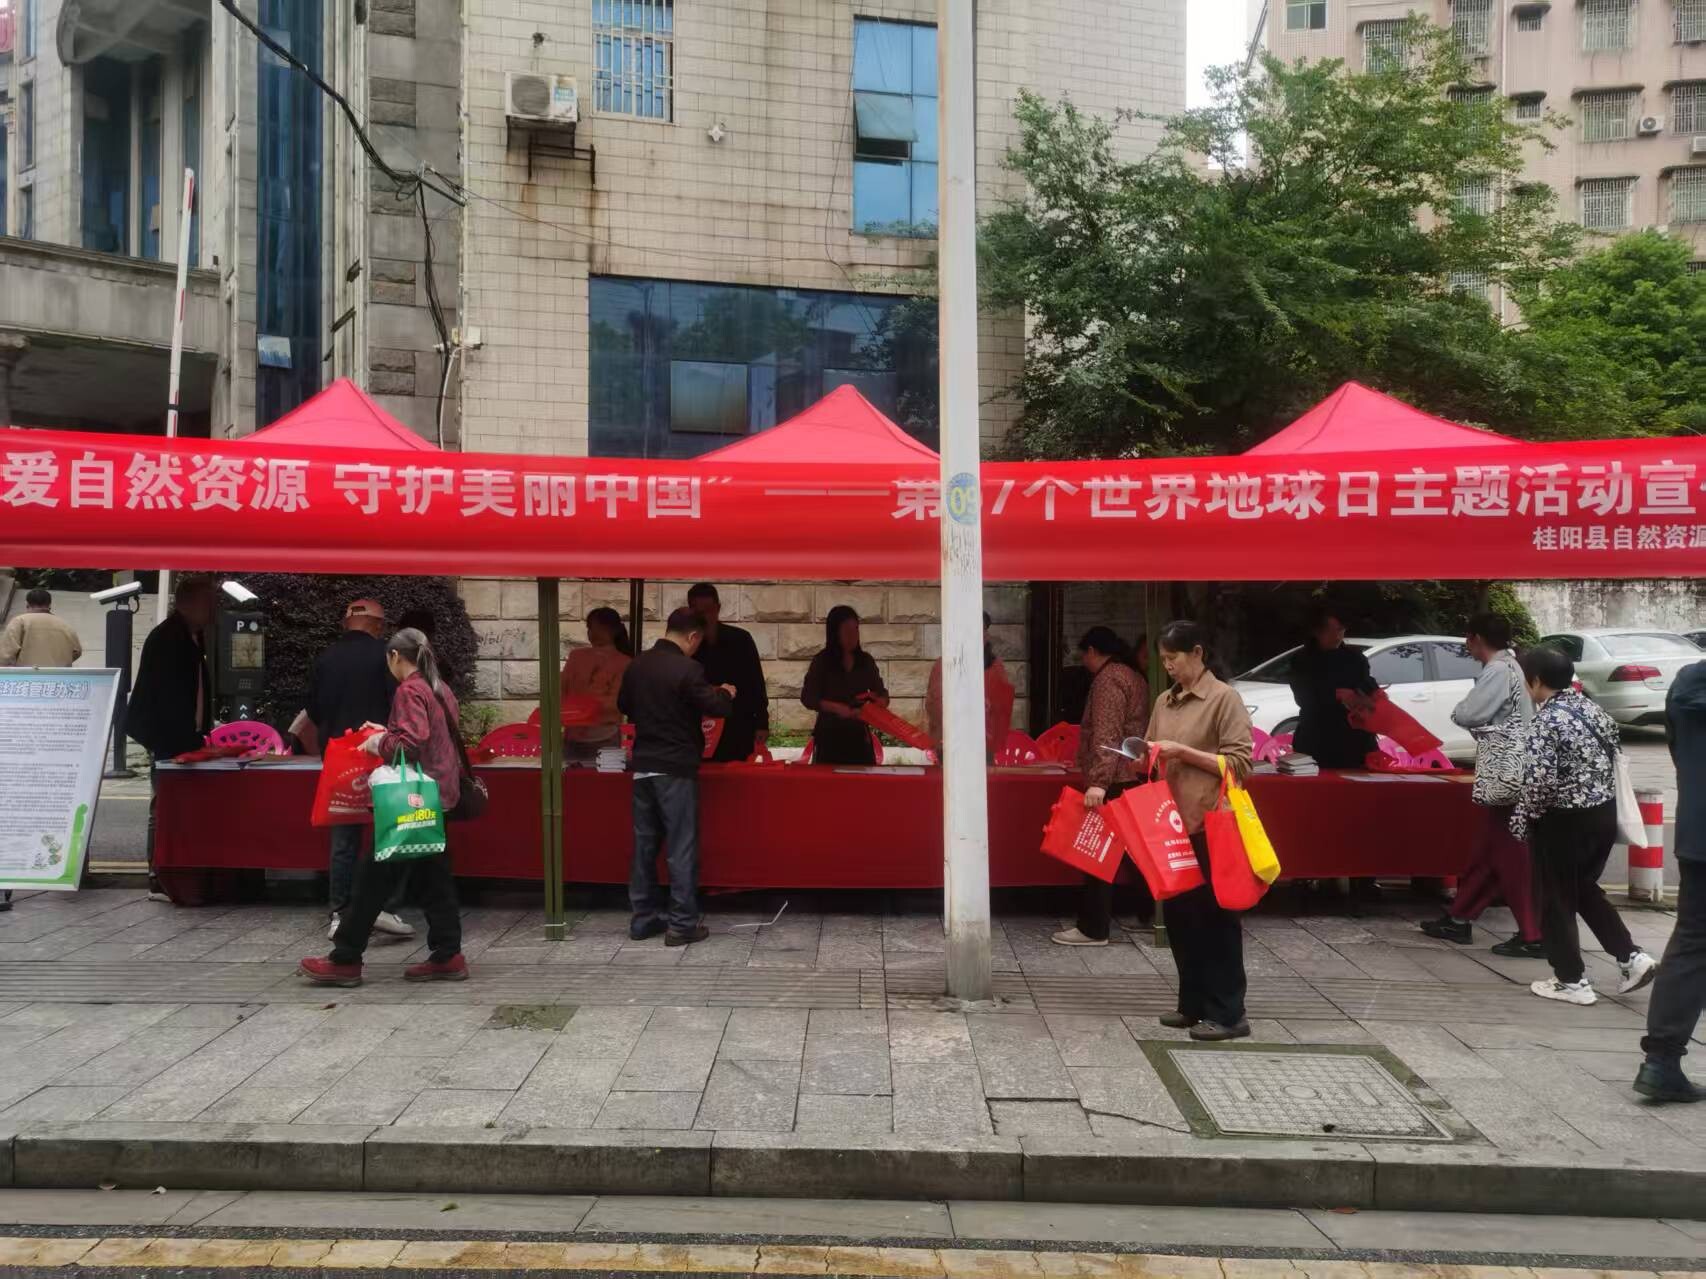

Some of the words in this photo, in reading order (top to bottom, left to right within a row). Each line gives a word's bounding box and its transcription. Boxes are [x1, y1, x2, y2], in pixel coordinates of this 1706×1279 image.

[0, 451, 310, 514] 爱自然资源
[236, 620, 246, 632] P
